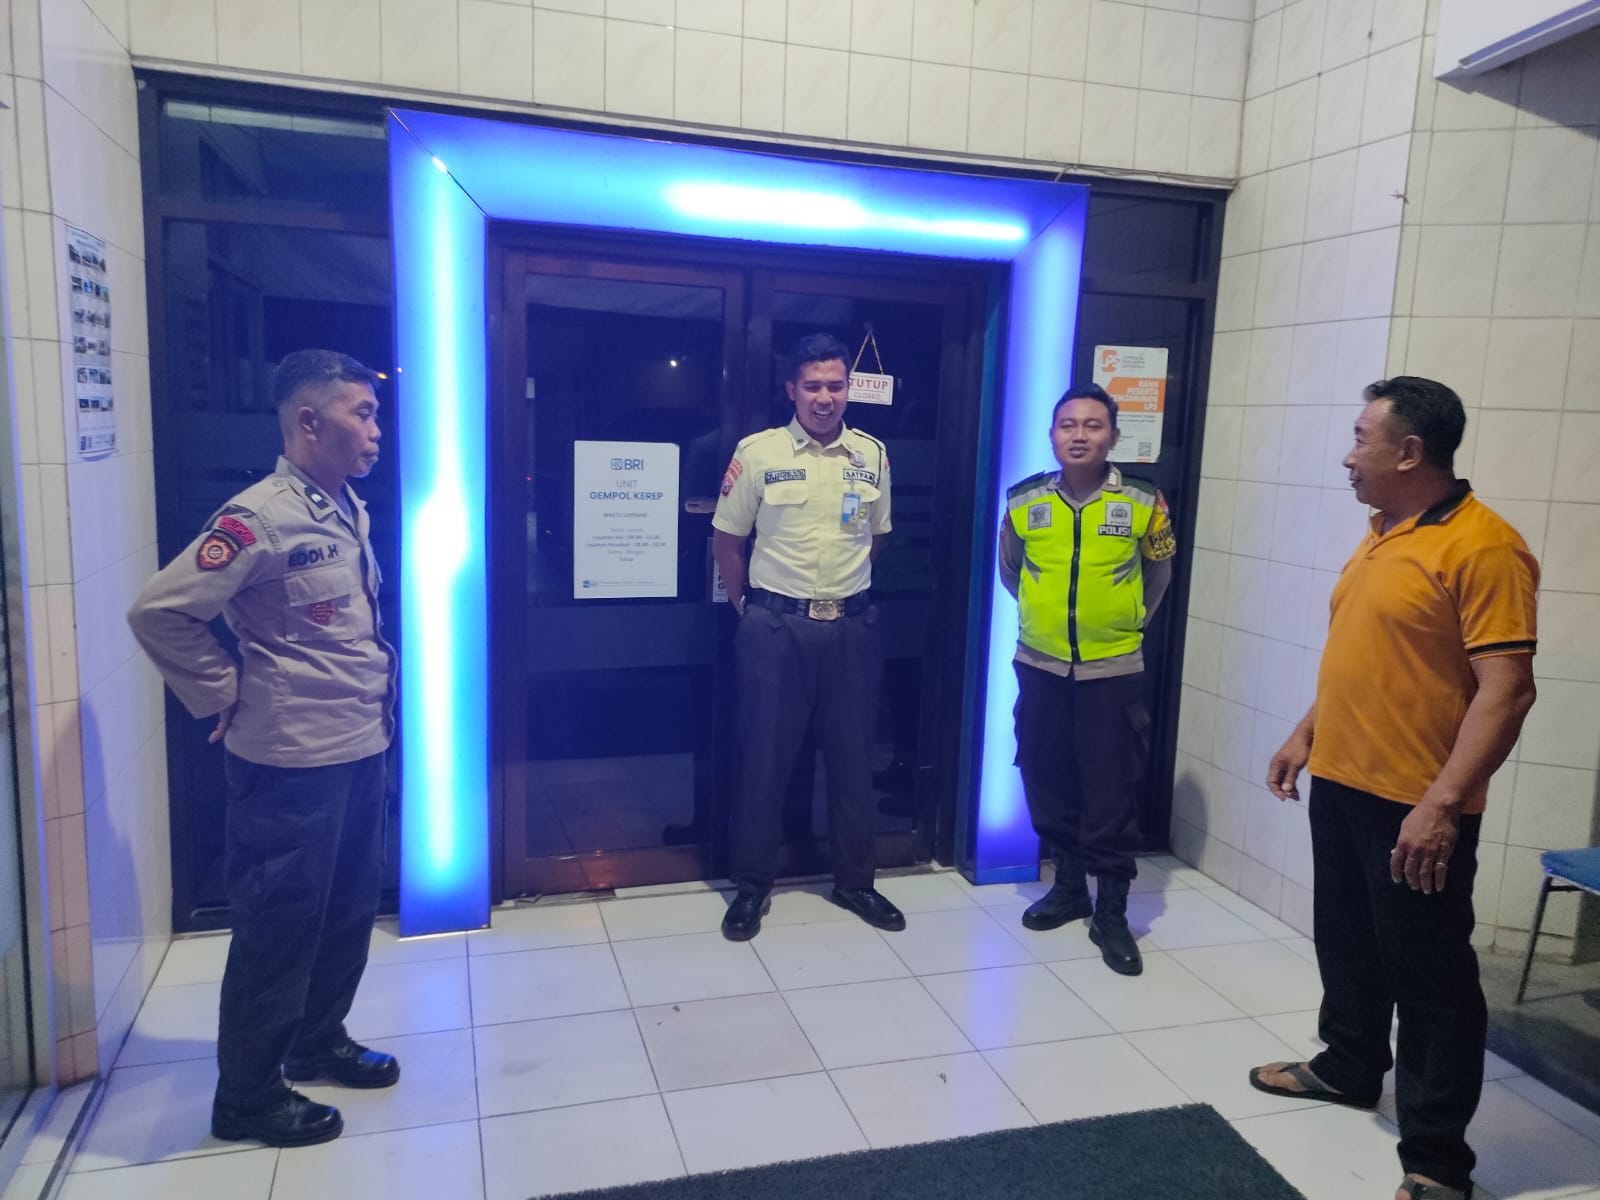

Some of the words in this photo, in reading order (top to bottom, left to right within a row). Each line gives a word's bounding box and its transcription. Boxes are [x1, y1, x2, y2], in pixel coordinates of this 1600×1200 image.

[848, 377, 888, 390] TUTUP
[624, 458, 644, 471] BRI
[616, 480, 638, 488] UNIT
[590, 491, 632, 500] GEMPOL
[634, 492, 664, 501] KEREP
[1098, 526, 1131, 536] POLISI
